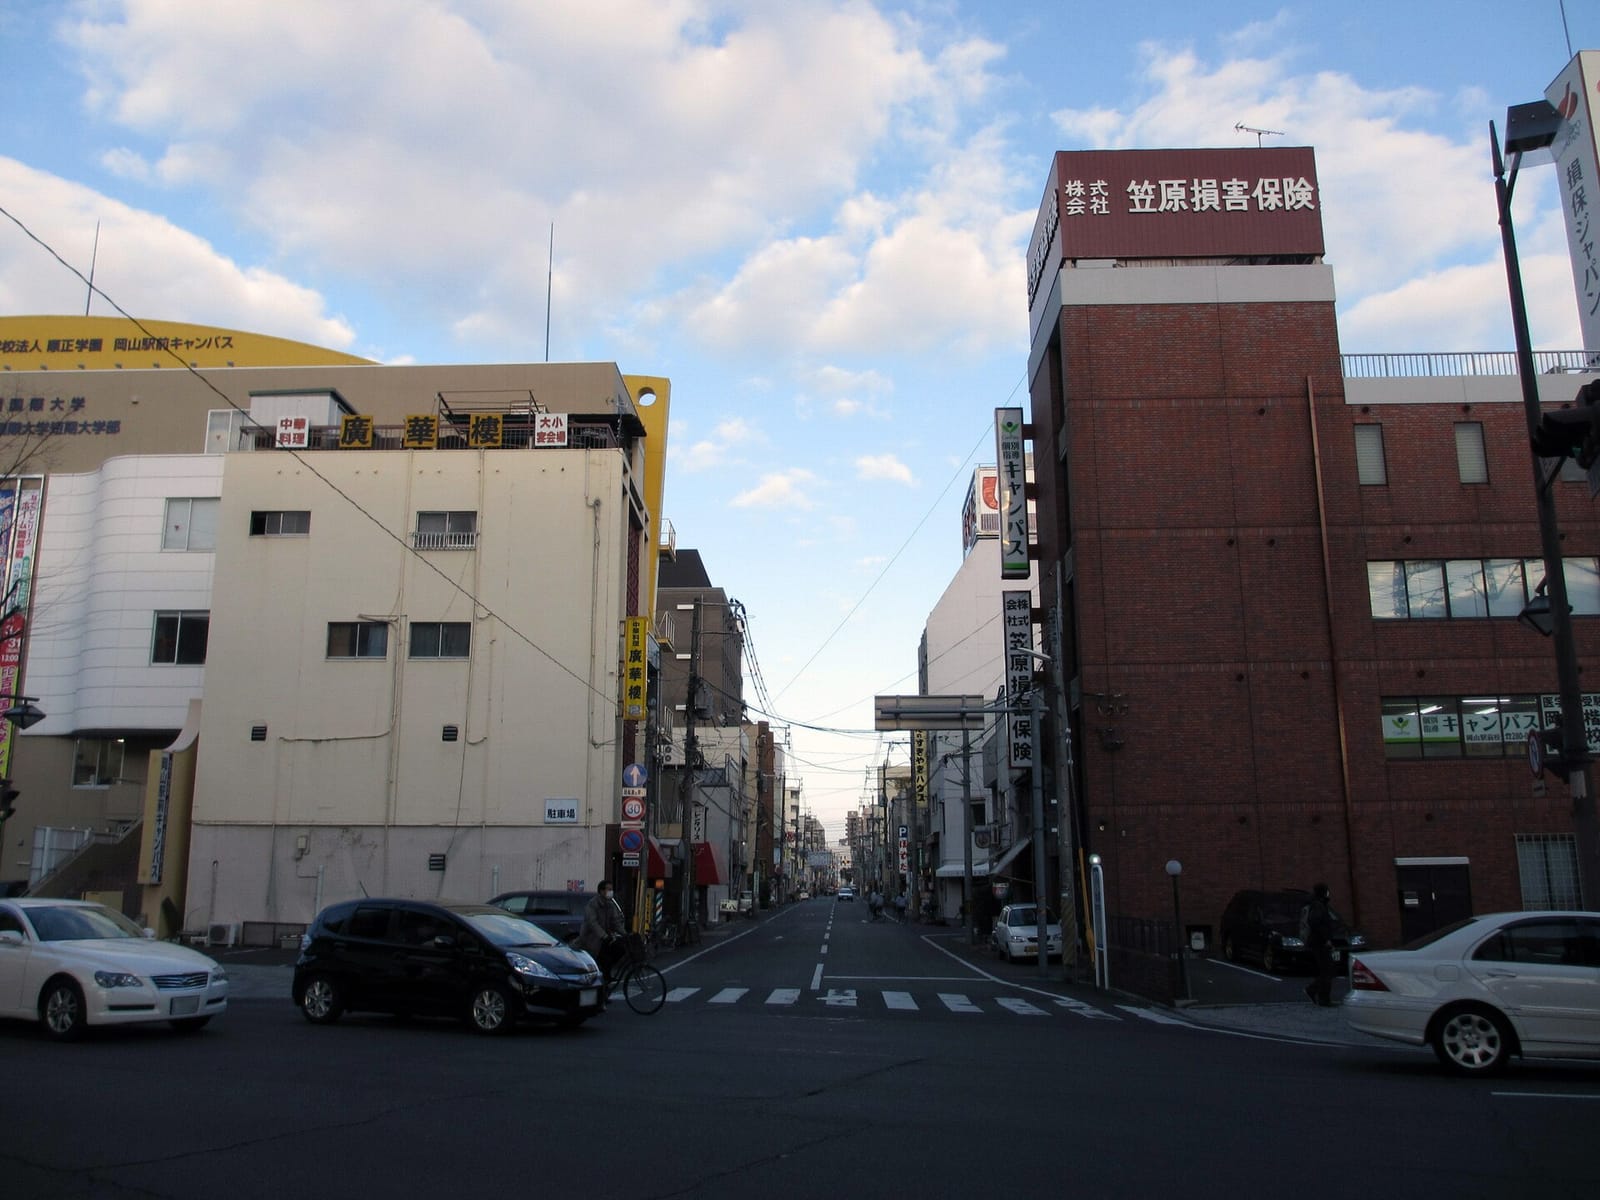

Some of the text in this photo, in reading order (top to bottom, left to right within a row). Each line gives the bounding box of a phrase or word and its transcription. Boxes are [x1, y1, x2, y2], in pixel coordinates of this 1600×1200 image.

[1063, 176, 1317, 213] 株式 笠原損害保険
[1065, 196, 1112, 216] 会社
[1567, 157, 1600, 318] 損保ジャパン
[113, 335, 234, 352] 岡山駅前キャンパス
[1003, 461, 1025, 556] キャンパス
[1443, 714, 1538, 732] キャンパス
[627, 803, 641, 814] 30
